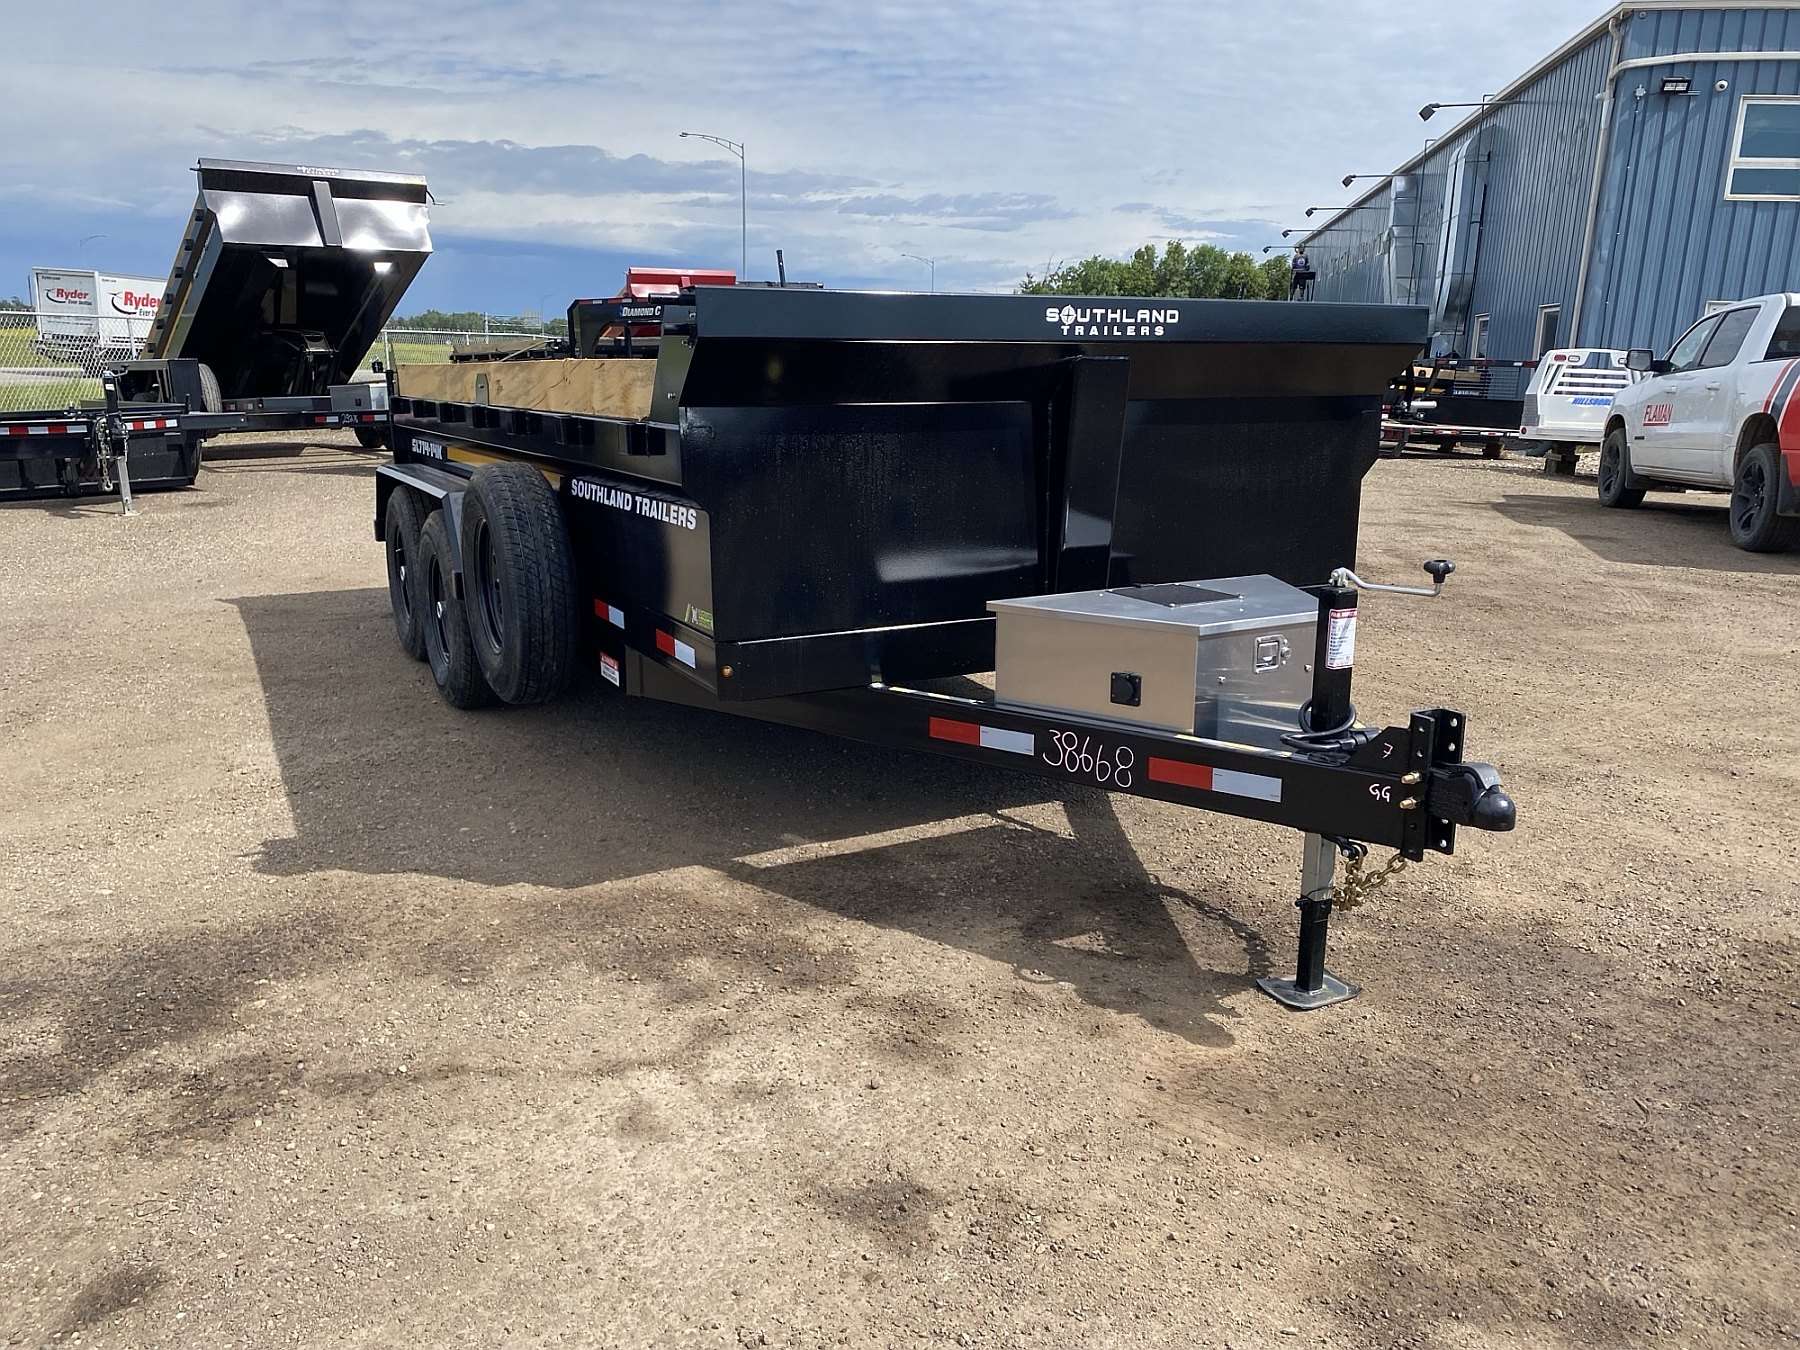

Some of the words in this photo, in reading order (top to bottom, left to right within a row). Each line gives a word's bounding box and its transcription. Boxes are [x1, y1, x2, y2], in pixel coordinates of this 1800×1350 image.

[56, 288, 89, 300] Ryder
[124, 291, 161, 310] Ryder
[655, 305, 662, 316] C
[1045, 304, 1179, 325] SOUTHLAND
[1061, 325, 1165, 336] TRAILERS
[1643, 404, 1674, 422] FLAMAN
[571, 479, 632, 511] SOUTHLAND
[635, 495, 697, 530] TRAILERS
[1042, 729, 1134, 788] 38668
